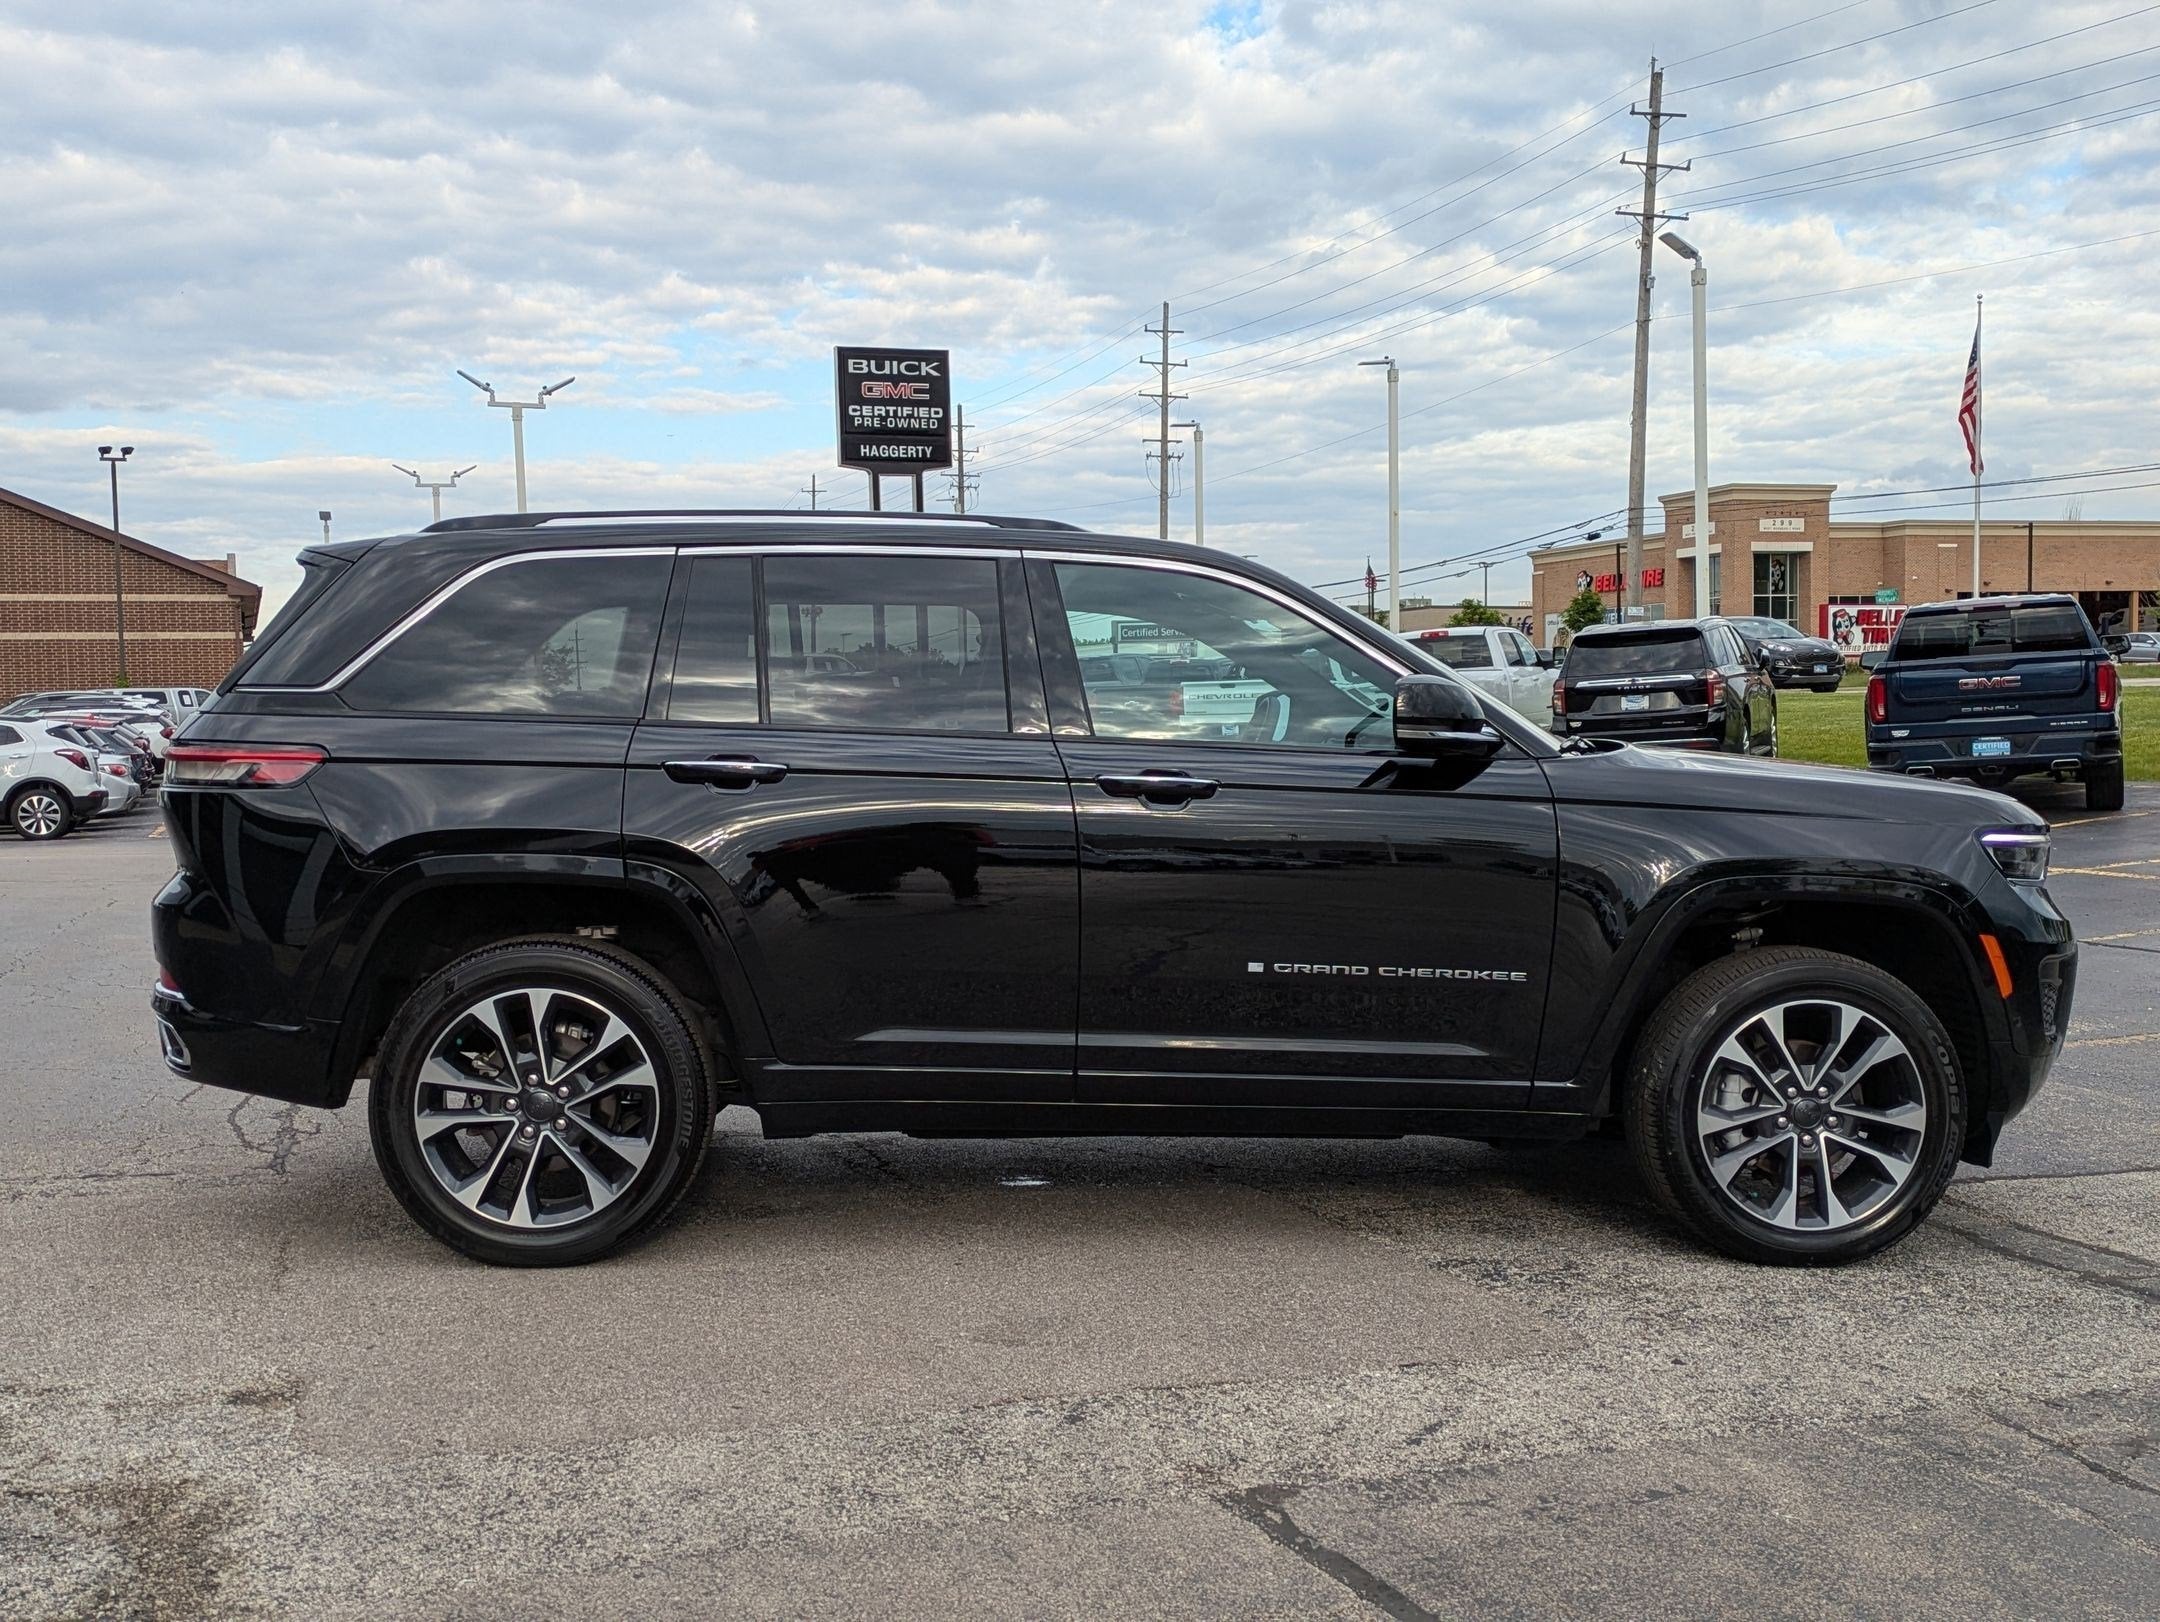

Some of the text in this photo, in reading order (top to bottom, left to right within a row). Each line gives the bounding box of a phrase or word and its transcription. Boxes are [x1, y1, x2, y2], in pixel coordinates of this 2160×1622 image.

[847, 358, 942, 377] BUICK
[861, 381, 930, 400] GMC
[848, 405, 943, 418] CERTIFIED
[854, 417, 938, 429] PRE-OWNED
[860, 444, 933, 458] HAGGERTY
[1642, 568, 1665, 588] IRE
[1121, 627, 1159, 637] Certified
[1958, 675, 2022, 690] GMC
[1188, 692, 1261, 700] CHEVROLE
[1961, 704, 2020, 713] DENALI
[1972, 740, 2011, 751] CERTIFIED
[1273, 963, 1528, 982] GRAND CHEROKEE
